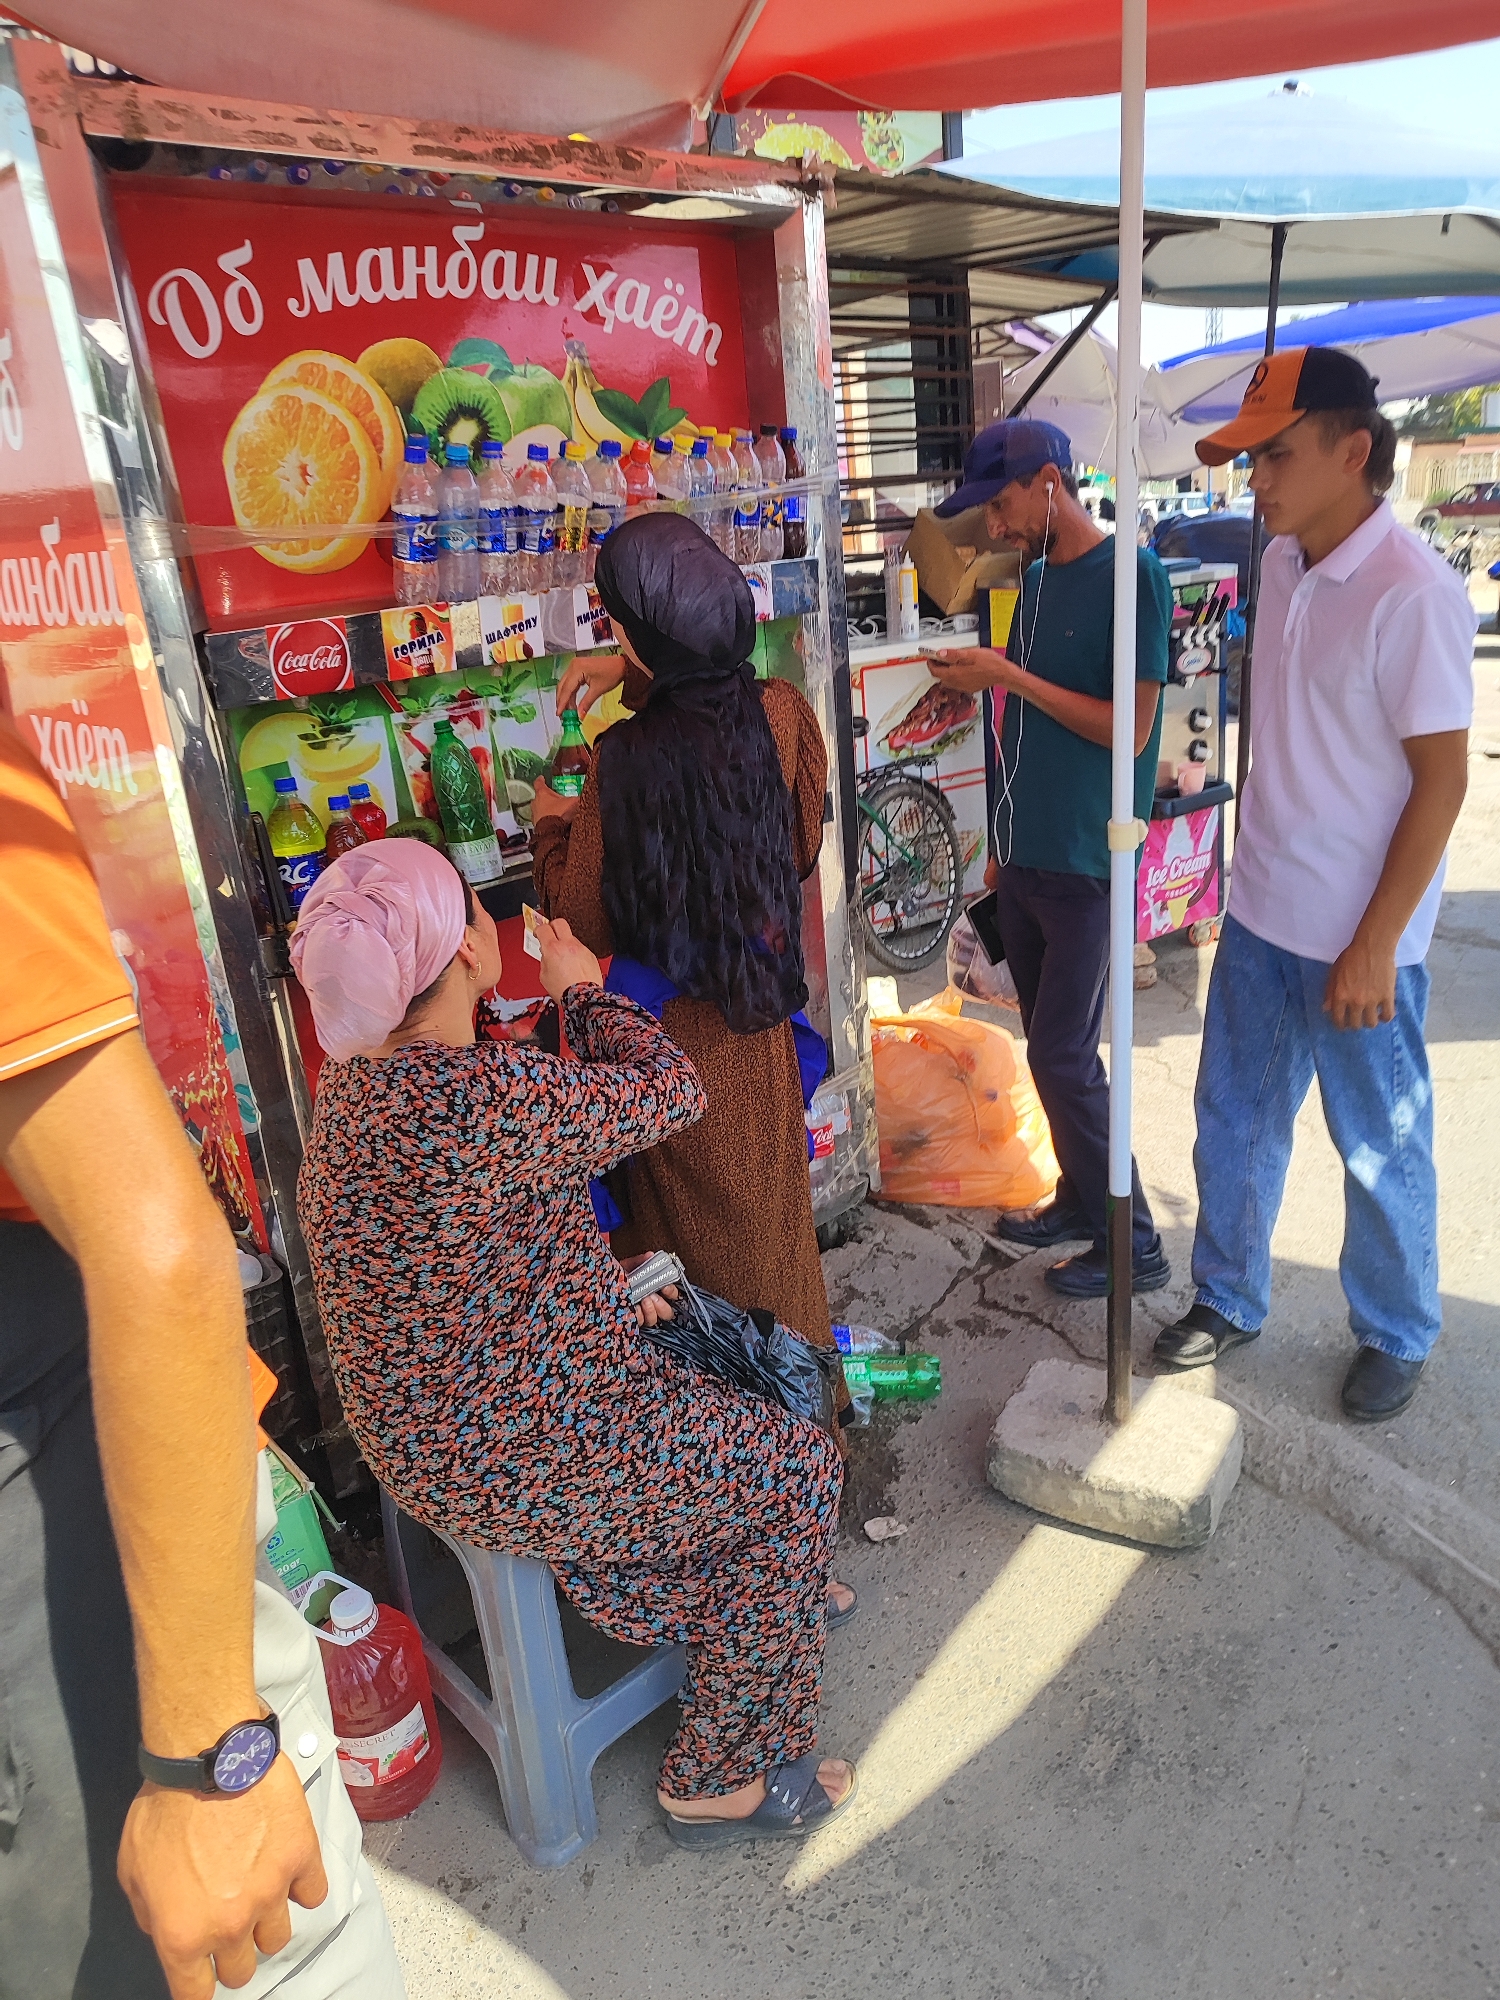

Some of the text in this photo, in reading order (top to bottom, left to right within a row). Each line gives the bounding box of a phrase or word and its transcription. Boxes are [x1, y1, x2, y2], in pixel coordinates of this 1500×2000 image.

[148, 239, 263, 359] Об
[287, 222, 559, 318] манбаи
[0, 516, 124, 627] анбаи
[485, 615, 538, 645] ШАФТОЛУ
[577, 607, 608, 627] ЛИМО
[393, 631, 445, 659] ГОРИЛА
[278, 861, 310, 884] RC
[1145, 852, 1212, 889] Ice Cream
